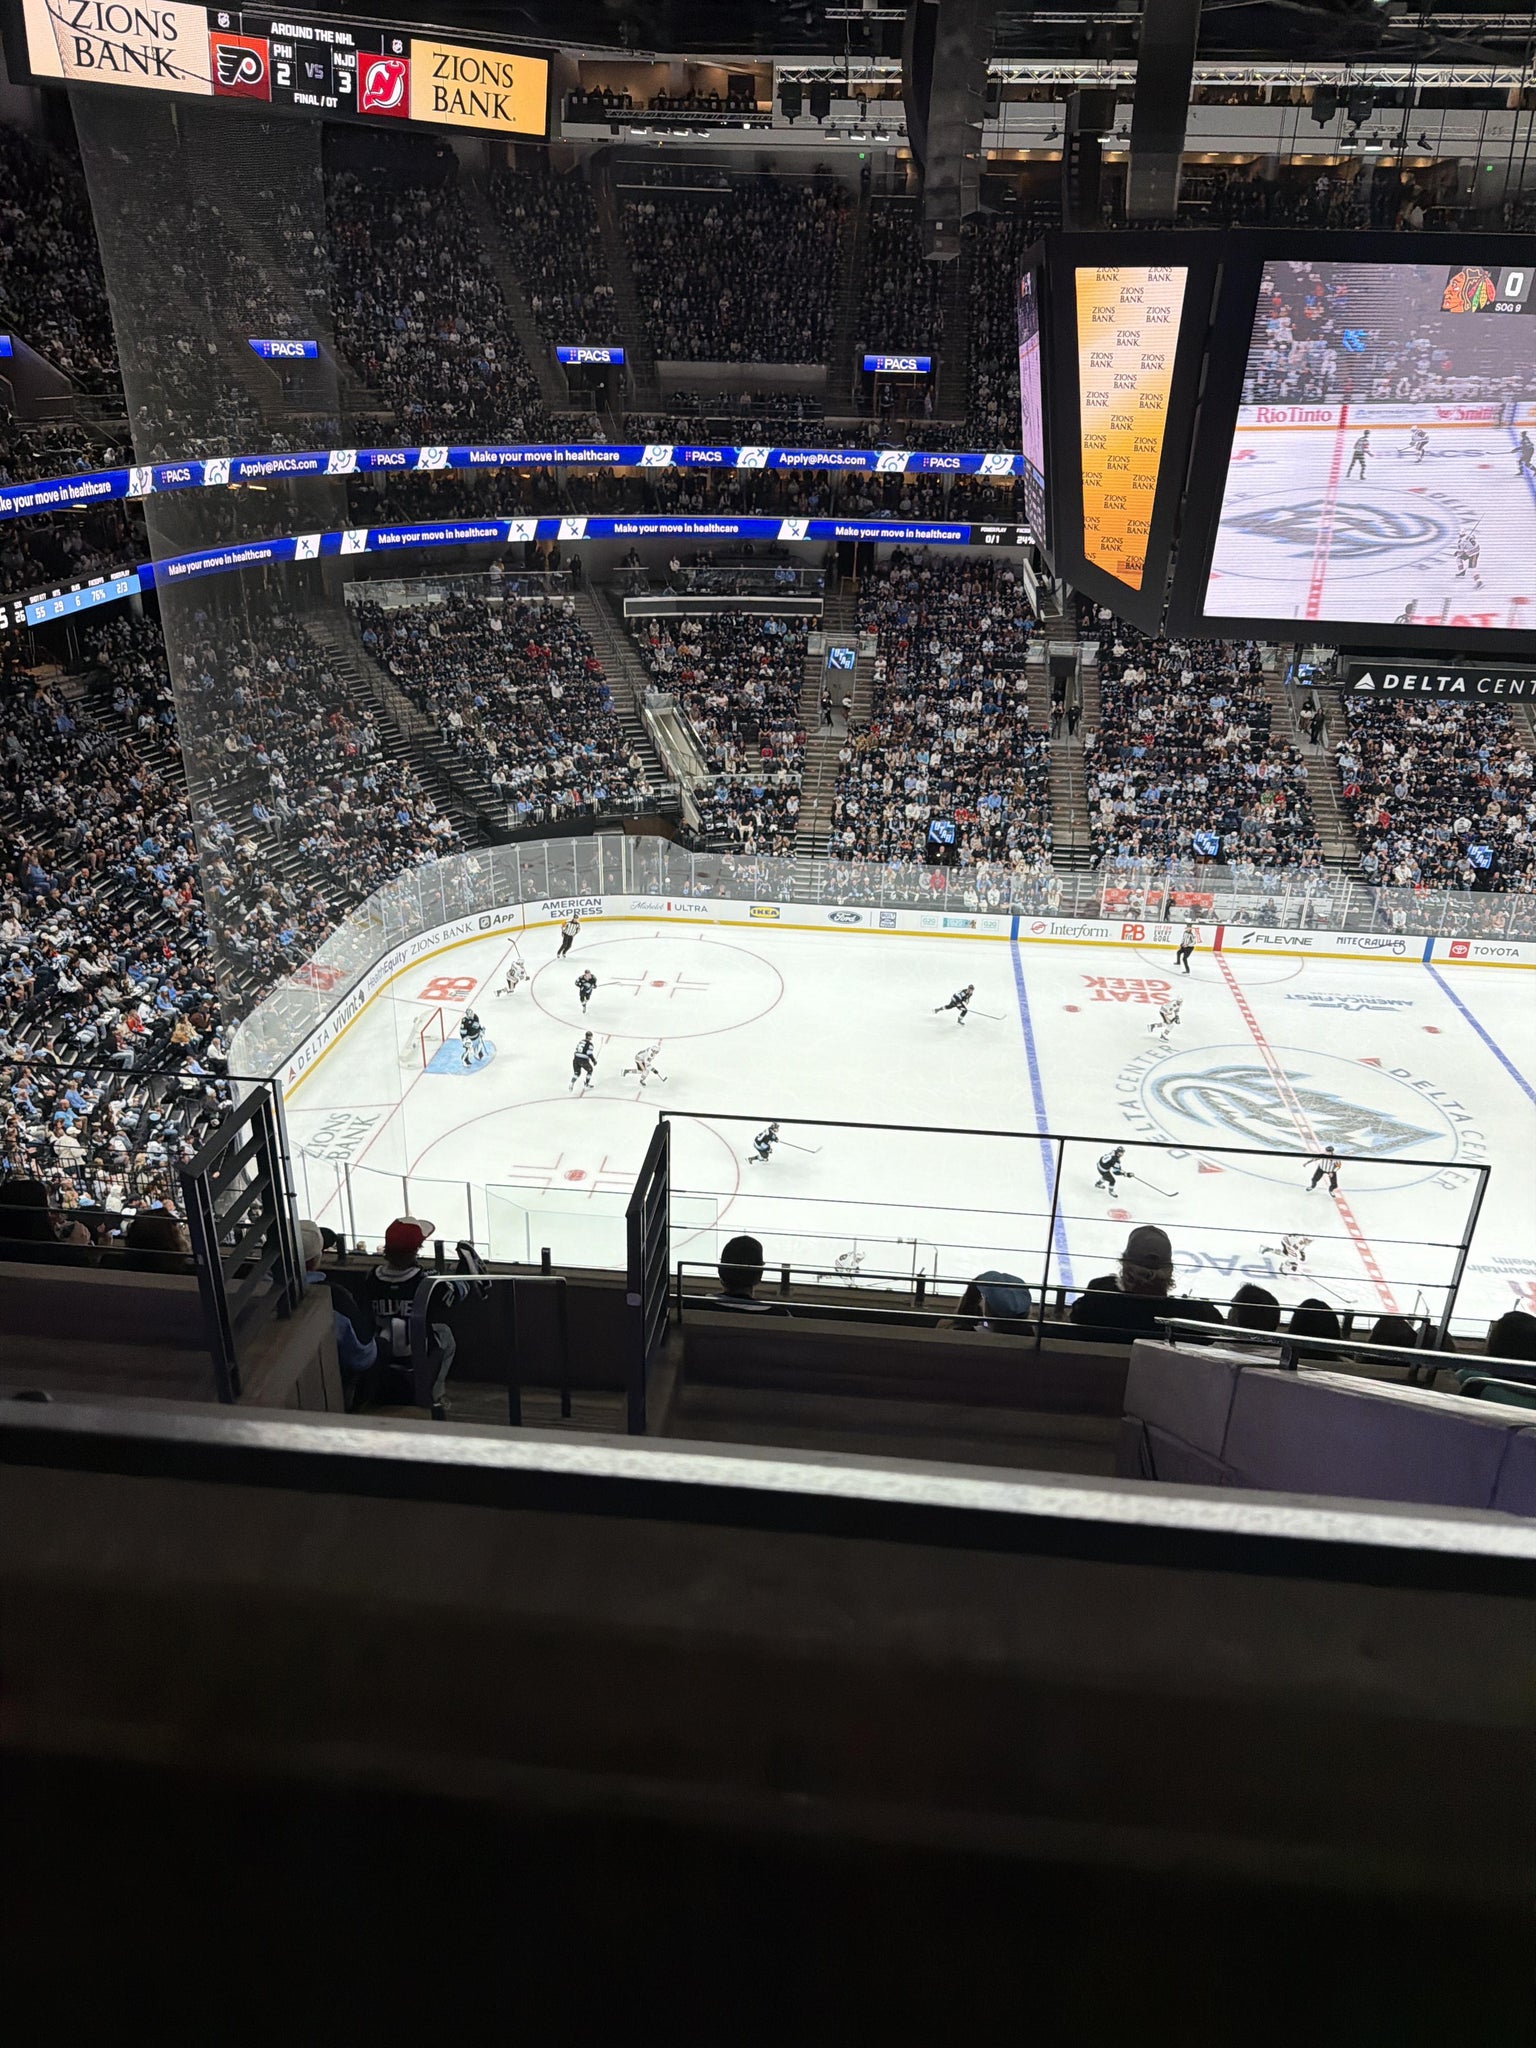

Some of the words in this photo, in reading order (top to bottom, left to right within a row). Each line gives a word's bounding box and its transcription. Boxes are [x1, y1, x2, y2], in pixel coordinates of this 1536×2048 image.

[68, 0, 178, 41] ZIONS
[271, 22, 313, 41] AROUND
[314, 28, 334, 43] THE
[335, 32, 355, 46] NHL
[70, 35, 182, 80] BANK
[273, 44, 292, 59] PHI
[334, 52, 355, 67] NJD
[432, 51, 514, 89] ZIONS
[276, 63, 291, 86] 2
[304, 62, 324, 80] VS
[338, 71, 351, 94] 3
[294, 92, 319, 107] FINAL
[326, 97, 338, 108] OT
[432, 85, 514, 122] BANK
[1505, 272, 1524, 296] 0
[1092, 306, 1115, 314] ZIONS
[1495, 303, 1514, 312] SOG
[1515, 304, 1521, 312] 9
[1146, 315, 1170, 323] BANK
[1117, 330, 1140, 338] ZIONS
[271, 343, 305, 356] PACS
[577, 350, 611, 362] PACS
[1090, 352, 1113, 360] ZIONS
[884, 358, 917, 370] PACS
[1090, 360, 1113, 368] BANK
[1140, 362, 1164, 370] BANK
[1114, 373, 1137, 381] ZIONS
[1113, 382, 1136, 390] BANK
[1086, 399, 1108, 407] BANK
[1140, 393, 1163, 401] ZIONS
[1139, 401, 1163, 409] BANK
[1133, 445, 1157, 453] BANK
[377, 453, 406, 465] PACS
[470, 451, 497, 462] Make
[500, 452, 522, 464] your
[524, 452, 552, 461] move
[554, 450, 563, 461] in
[565, 450, 620, 461] healthcare
[691, 451, 722, 462] PACS
[779, 452, 866, 466] Apply@PACS.com
[1107, 455, 1130, 463] ZIONS
[240, 458, 317, 476] Apply@PACS.com
[930, 458, 960, 469] PACS
[167, 468, 191, 483] PACS
[1133, 474, 1156, 482] ZIONS
[1082, 479, 1102, 487] ANK
[1132, 482, 1155, 490] BANK
[13, 494, 34, 512] your
[35, 489, 59, 505] move
[60, 486, 68, 500] in
[69, 481, 111, 499] healthcare
[1104, 494, 1127, 502] ZIONS
[1103, 502, 1127, 510] BANK
[614, 523, 638, 533] Make
[639, 524, 658, 535] your
[660, 524, 683, 533] move
[684, 522, 692, 533] in
[694, 522, 739, 533] healthcare
[835, 526, 858, 536] Make
[860, 527, 881, 538] your
[883, 529, 904, 537] move
[906, 527, 914, 538] in
[915, 529, 961, 540] healthcare
[378, 532, 400, 544] Make
[402, 532, 420, 544] your
[421, 531, 444, 540] move
[445, 529, 453, 539] in
[455, 528, 498, 538] healthcare
[985, 534, 1000, 544] 0/1
[1016, 535, 1036, 545] 24%
[1101, 536, 1123, 544] ZIONS
[1100, 544, 1123, 552] BANK
[168, 563, 186, 576] Make
[187, 562, 203, 574] your
[203, 557, 224, 568] move
[224, 554, 232, 564] in
[232, 549, 272, 563] healthcare
[14, 609, 26, 624] 26
[35, 606, 46, 619] 55
[53, 600, 64, 613] 29
[75, 595, 81, 607] 6
[91, 588, 106, 602] 76%
[116, 581, 128, 594] 2/3
[1383, 674, 1466, 692] DELTA
[541, 898, 602, 910] AMERICAN
[674, 904, 708, 913] ULTRA
[550, 906, 603, 918] EXPRESS
[752, 908, 778, 916] IKEA
[833, 911, 856, 923] Ford
[1050, 922, 1109, 938] Interform
[1121, 923, 1146, 941] PB
[411, 933, 445, 955] ZIONS
[443, 921, 474, 941] BANK
[1255, 934, 1313, 946] FILEVINE
[1474, 946, 1520, 957] TOYOTA
[1080, 975, 1172, 991] GEEK
[1089, 989, 1171, 1005] SEAT
[298, 1029, 330, 1070] DELTA
[1116, 1043, 1180, 1093] CENTER
[1390, 1068, 1474, 1122] DELTA
[324, 1113, 381, 1160] BANK
[1431, 1130, 1487, 1191] CENER
[1173, 1250, 1278, 1280] PAC
